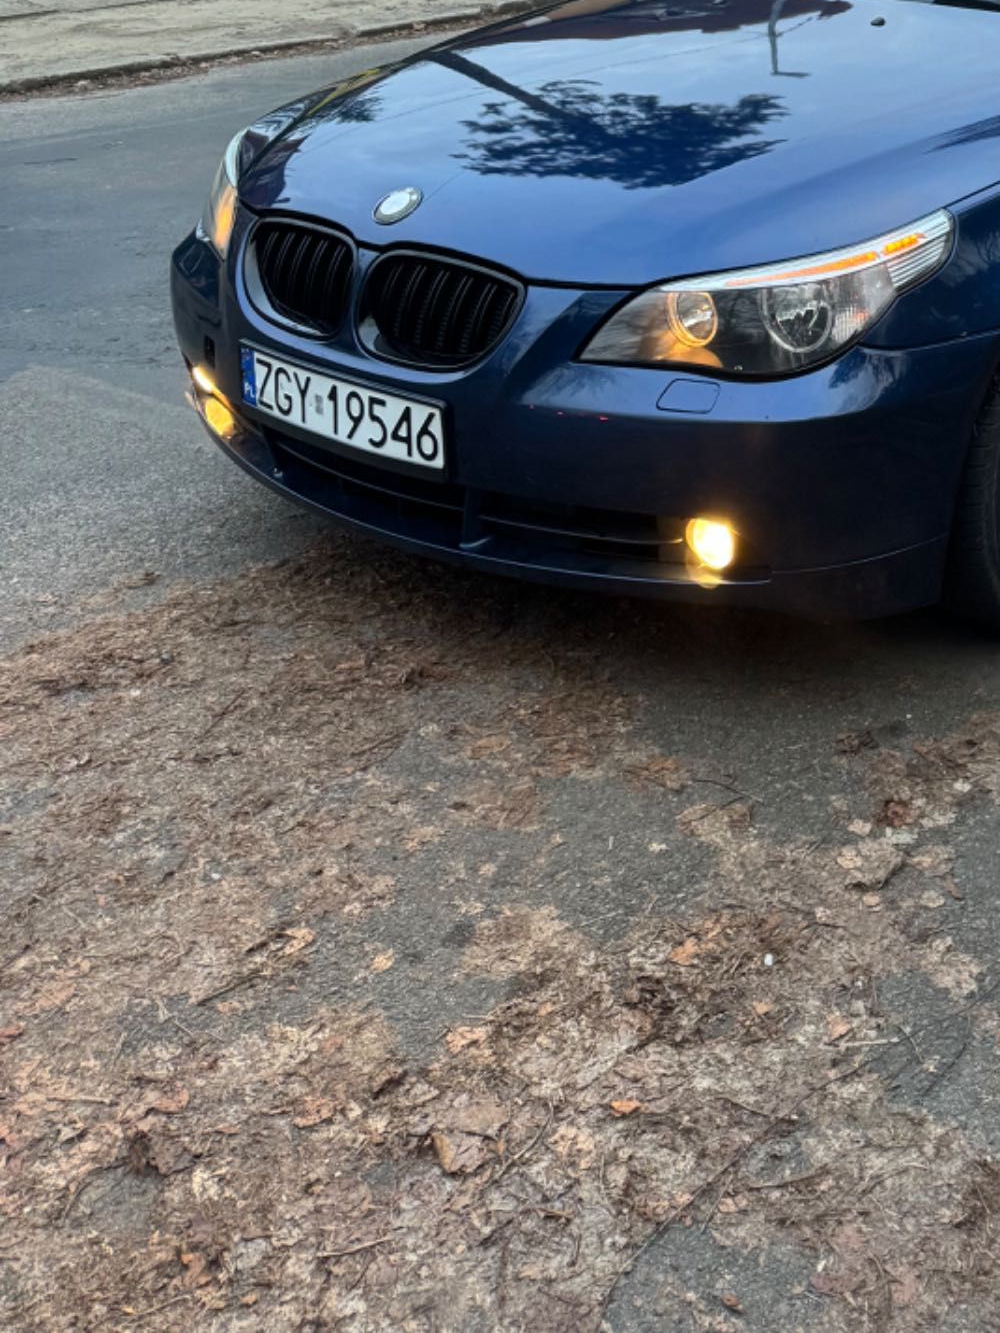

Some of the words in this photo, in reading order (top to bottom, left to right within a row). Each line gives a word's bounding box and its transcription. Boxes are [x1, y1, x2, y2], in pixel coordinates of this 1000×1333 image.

[243, 381, 256, 398] PL
[255, 356, 311, 424] ZGY
[327, 383, 439, 462] 19546
